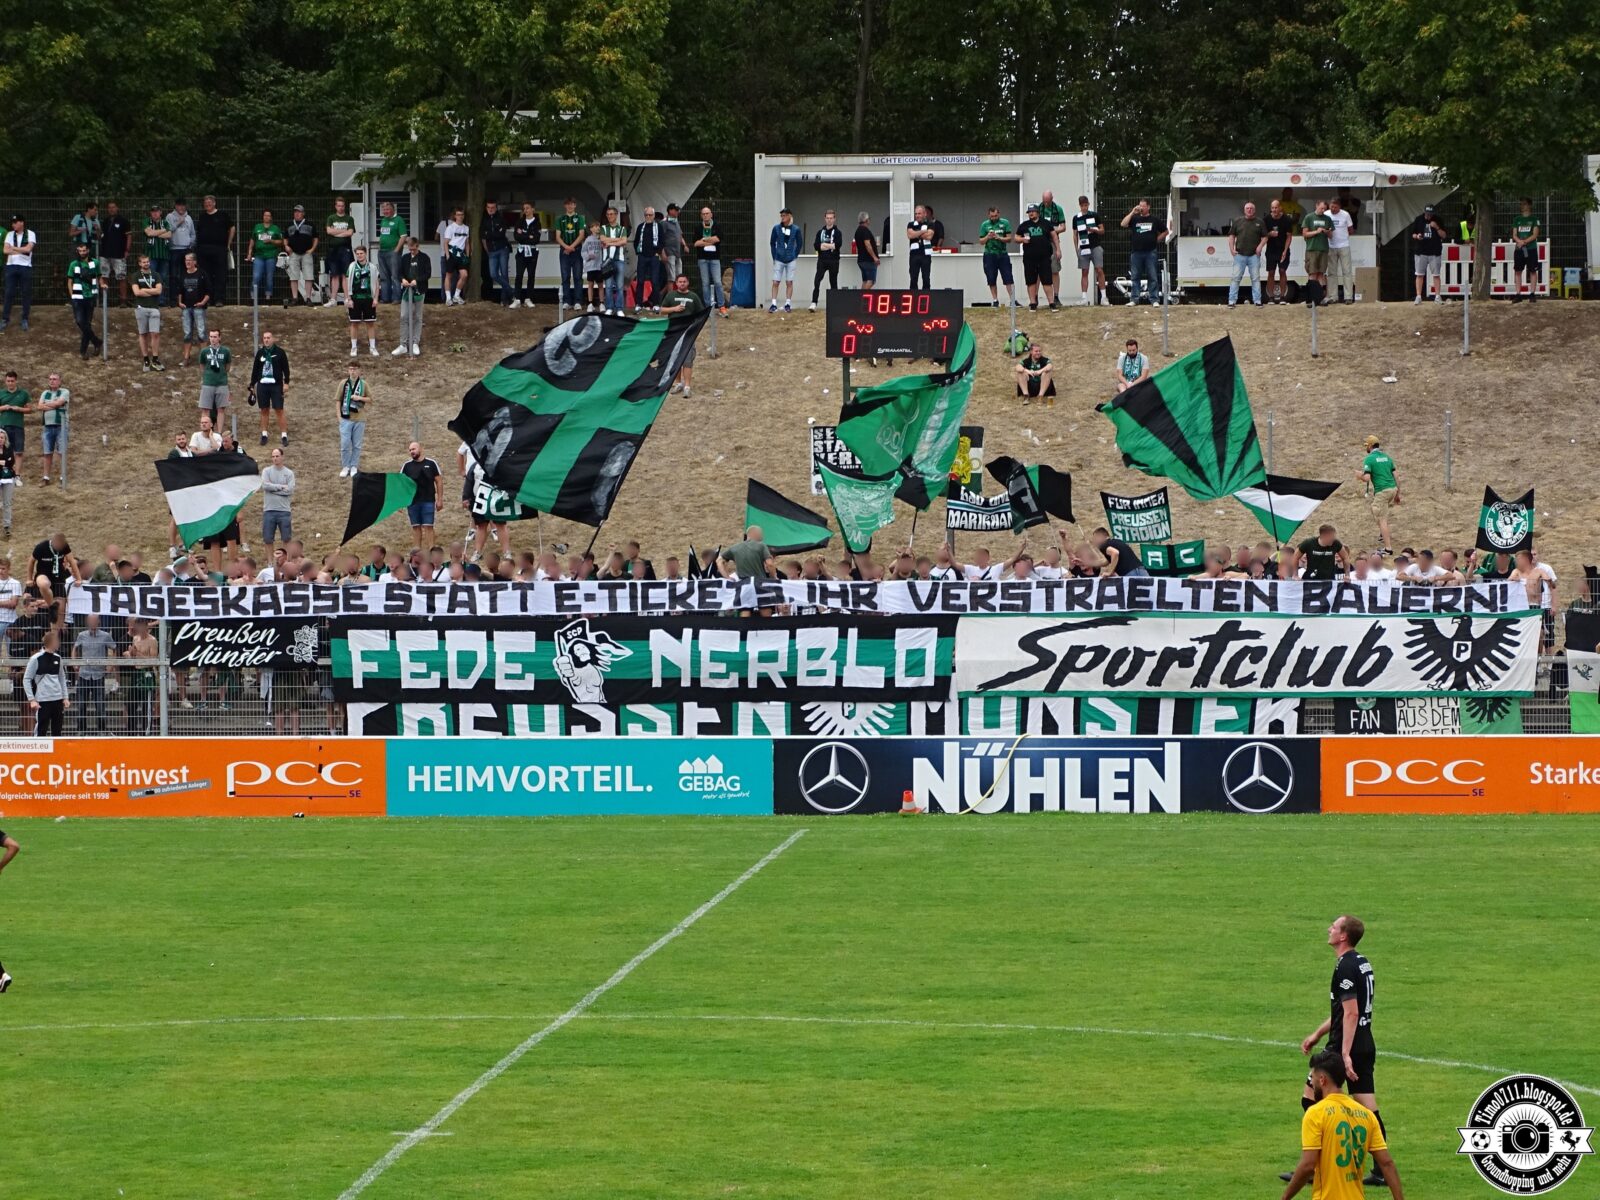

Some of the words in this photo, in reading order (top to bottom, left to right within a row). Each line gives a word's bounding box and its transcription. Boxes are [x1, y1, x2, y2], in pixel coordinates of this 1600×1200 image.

[843, 335, 856, 354] 0
[941, 335, 947, 354] 1
[1132, 492, 1165, 510] IMMER
[1111, 508, 1167, 527] PREUSSEN
[1113, 521, 1170, 542] STADION
[83, 584, 369, 617] TAGESKASSE
[384, 582, 534, 614] STATT
[807, 582, 877, 611] IHR
[907, 578, 1279, 612] VERSTRAELTEN
[1302, 582, 1508, 614] BAUERN!
[174, 621, 280, 645] Preußen
[566, 627, 582, 639] SCP
[173, 643, 282, 668] Münster
[347, 630, 536, 690] FEDE
[650, 627, 938, 689] NERBLO
[976, 616, 1394, 693] Sportclub
[1350, 709, 1381, 729] FAN
[1397, 707, 1428, 728] AUS
[1431, 707, 1461, 727] DEM
[0, 763, 190, 786] PCC.Direktinvest
[408, 765, 653, 792] HEIMVORTEIL.
[679, 775, 741, 792] GEBAG
[913, 741, 1181, 814] NÜHLEN
[33, 792, 78, 801] Wertpapiere
[79, 792, 91, 800] seit
[92, 792, 110, 800] 1998
[1472, 788, 1485, 796] SE
